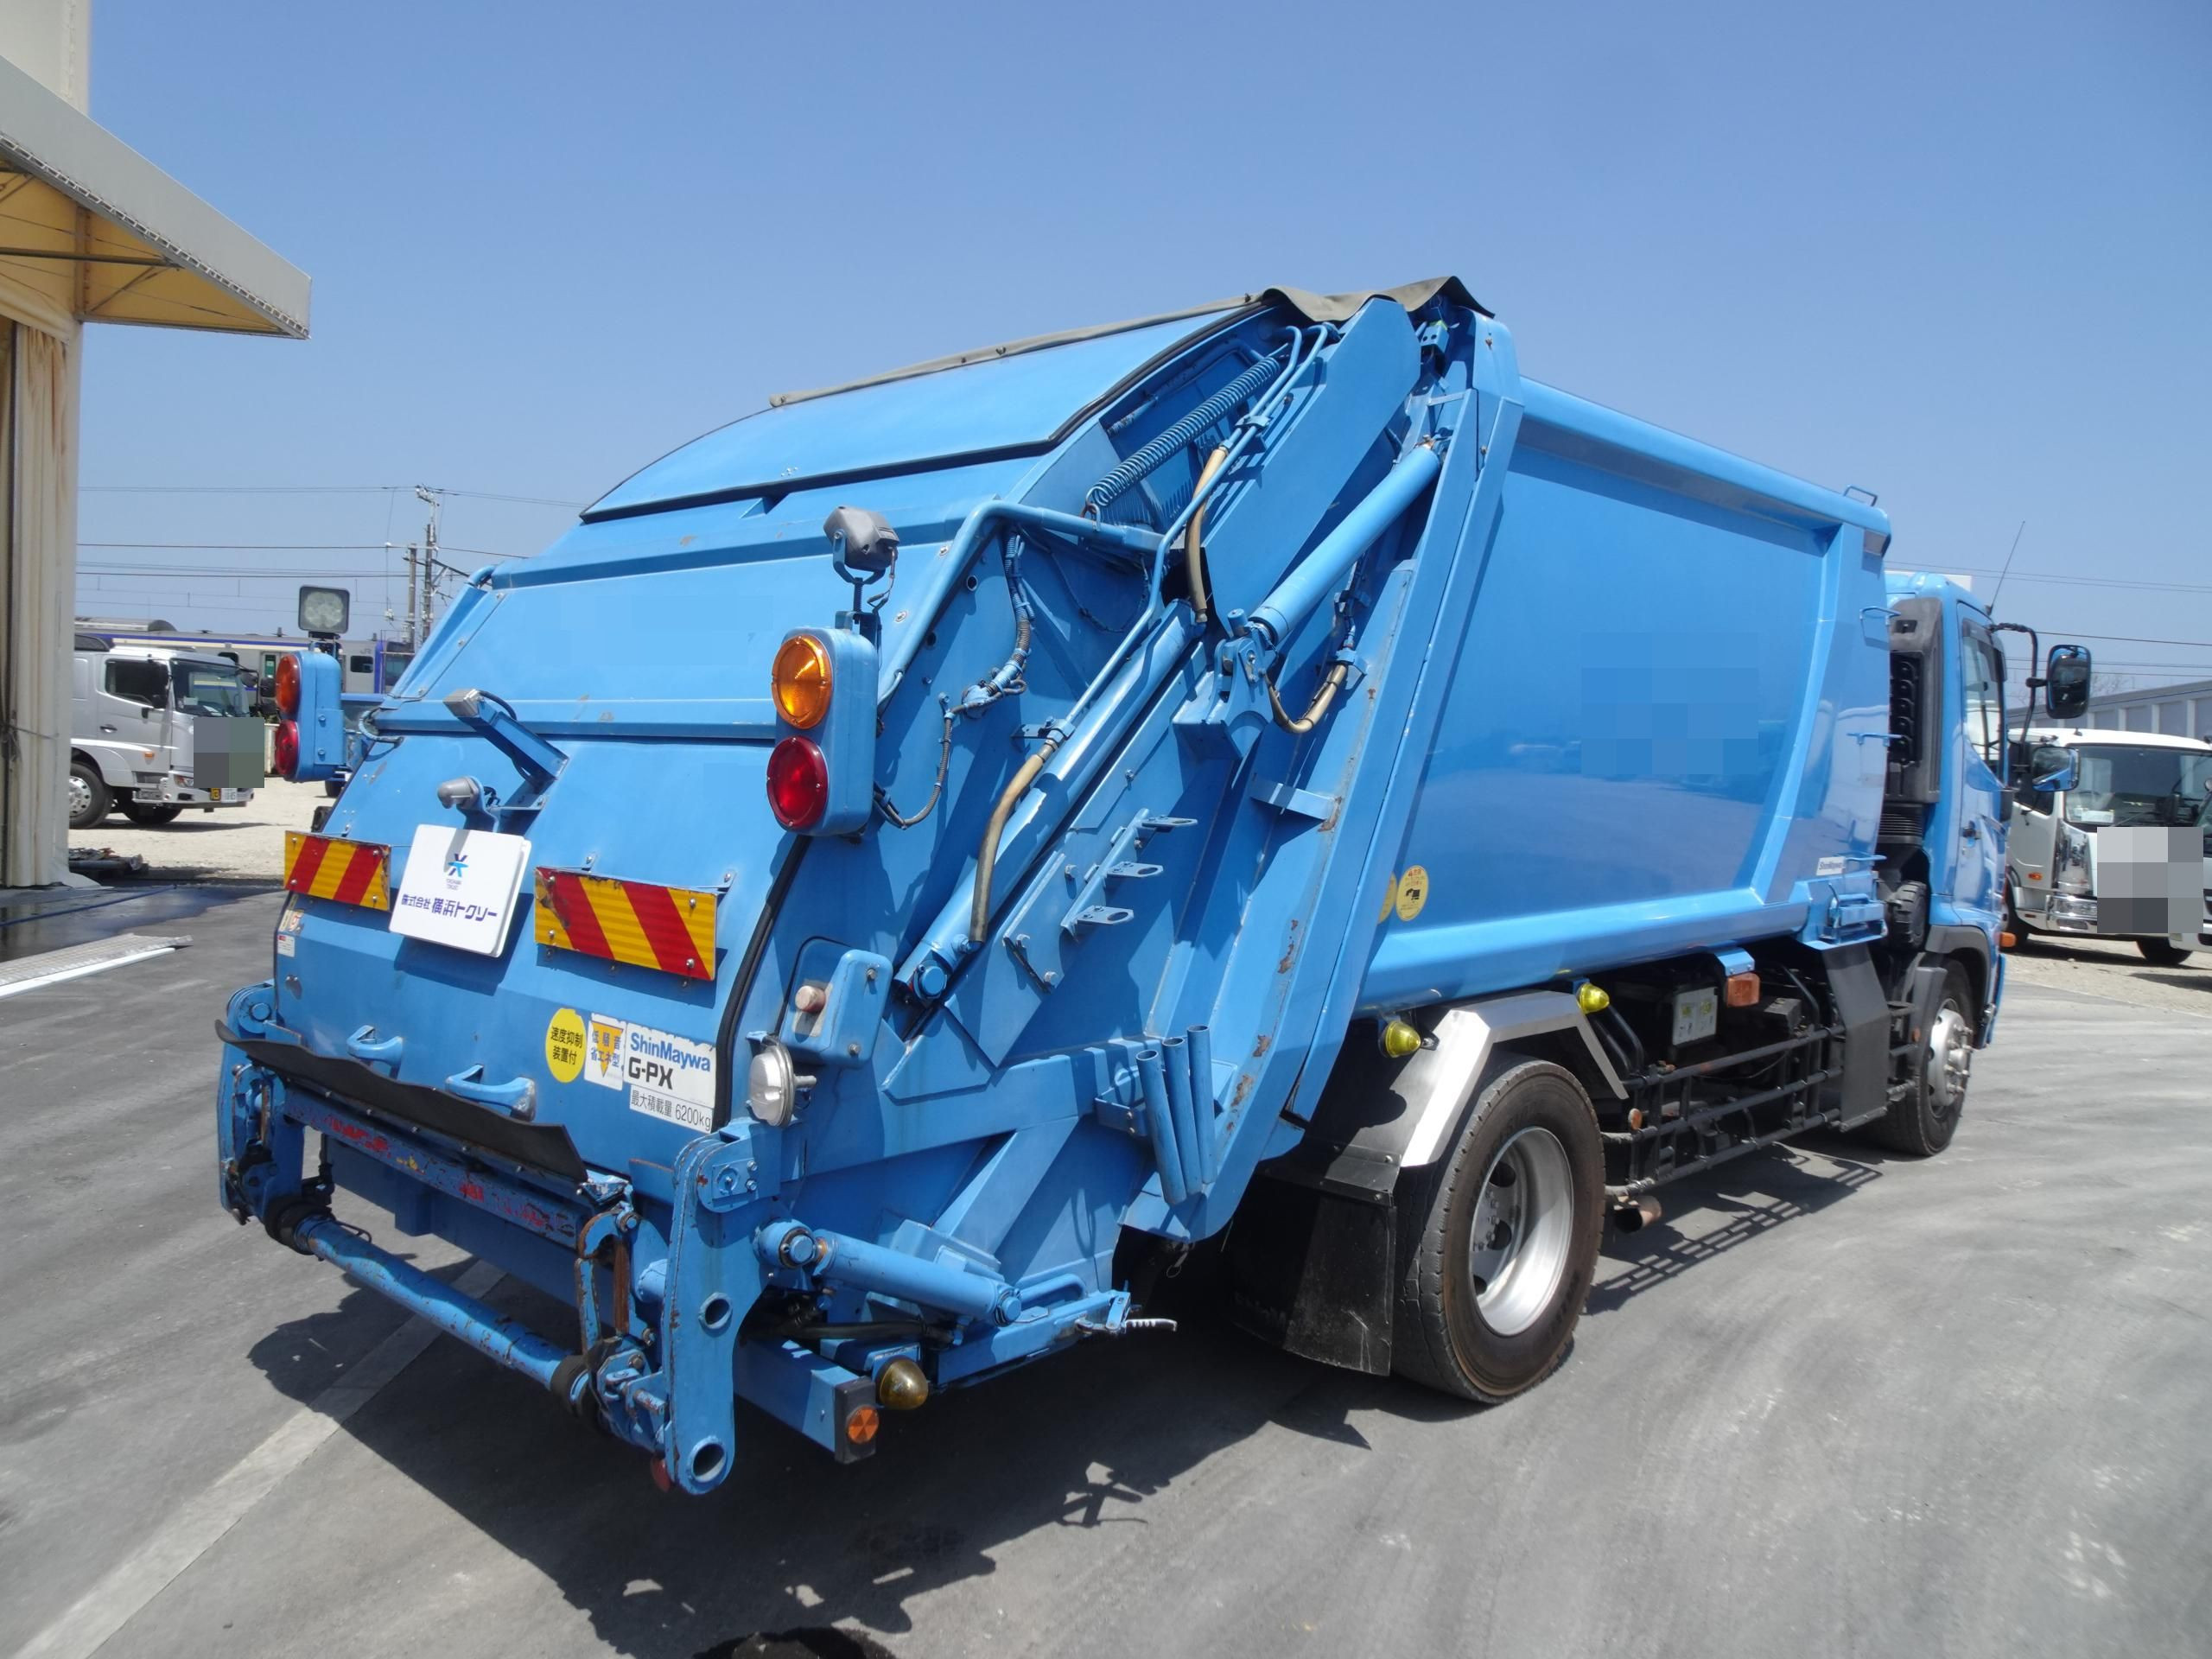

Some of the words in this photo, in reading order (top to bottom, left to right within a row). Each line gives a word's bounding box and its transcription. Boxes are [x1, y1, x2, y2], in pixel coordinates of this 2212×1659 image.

[553, 1045, 577, 1065] 装置付
[631, 1033, 710, 1071] ShinMaywa
[628, 1056, 673, 1090] G-PX
[631, 1090, 672, 1117] 最大積載量
[675, 1104, 710, 1131] 6200kg
